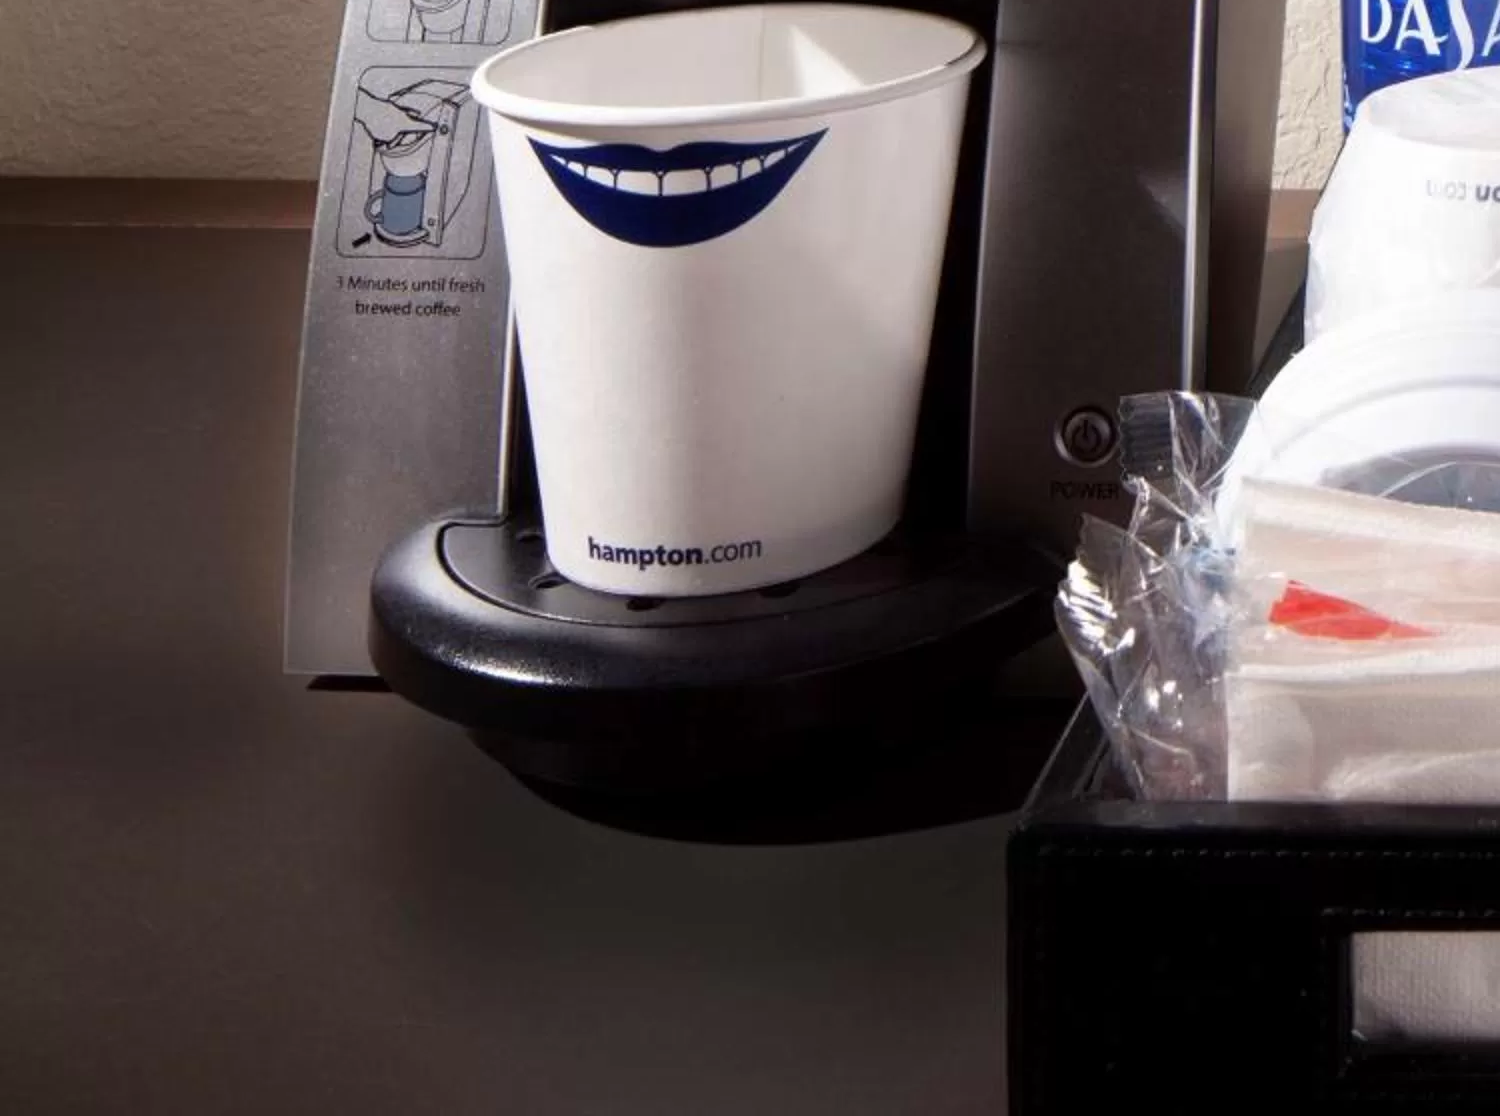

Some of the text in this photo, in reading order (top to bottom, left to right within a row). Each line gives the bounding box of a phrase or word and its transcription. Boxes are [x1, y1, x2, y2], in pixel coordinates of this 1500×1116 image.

[348, 275, 408, 292] Minutes
[412, 276, 447, 293] until
[449, 276, 486, 293] fresh
[355, 300, 462, 317] brewed coffee
[587, 535, 762, 571] hampton.com
